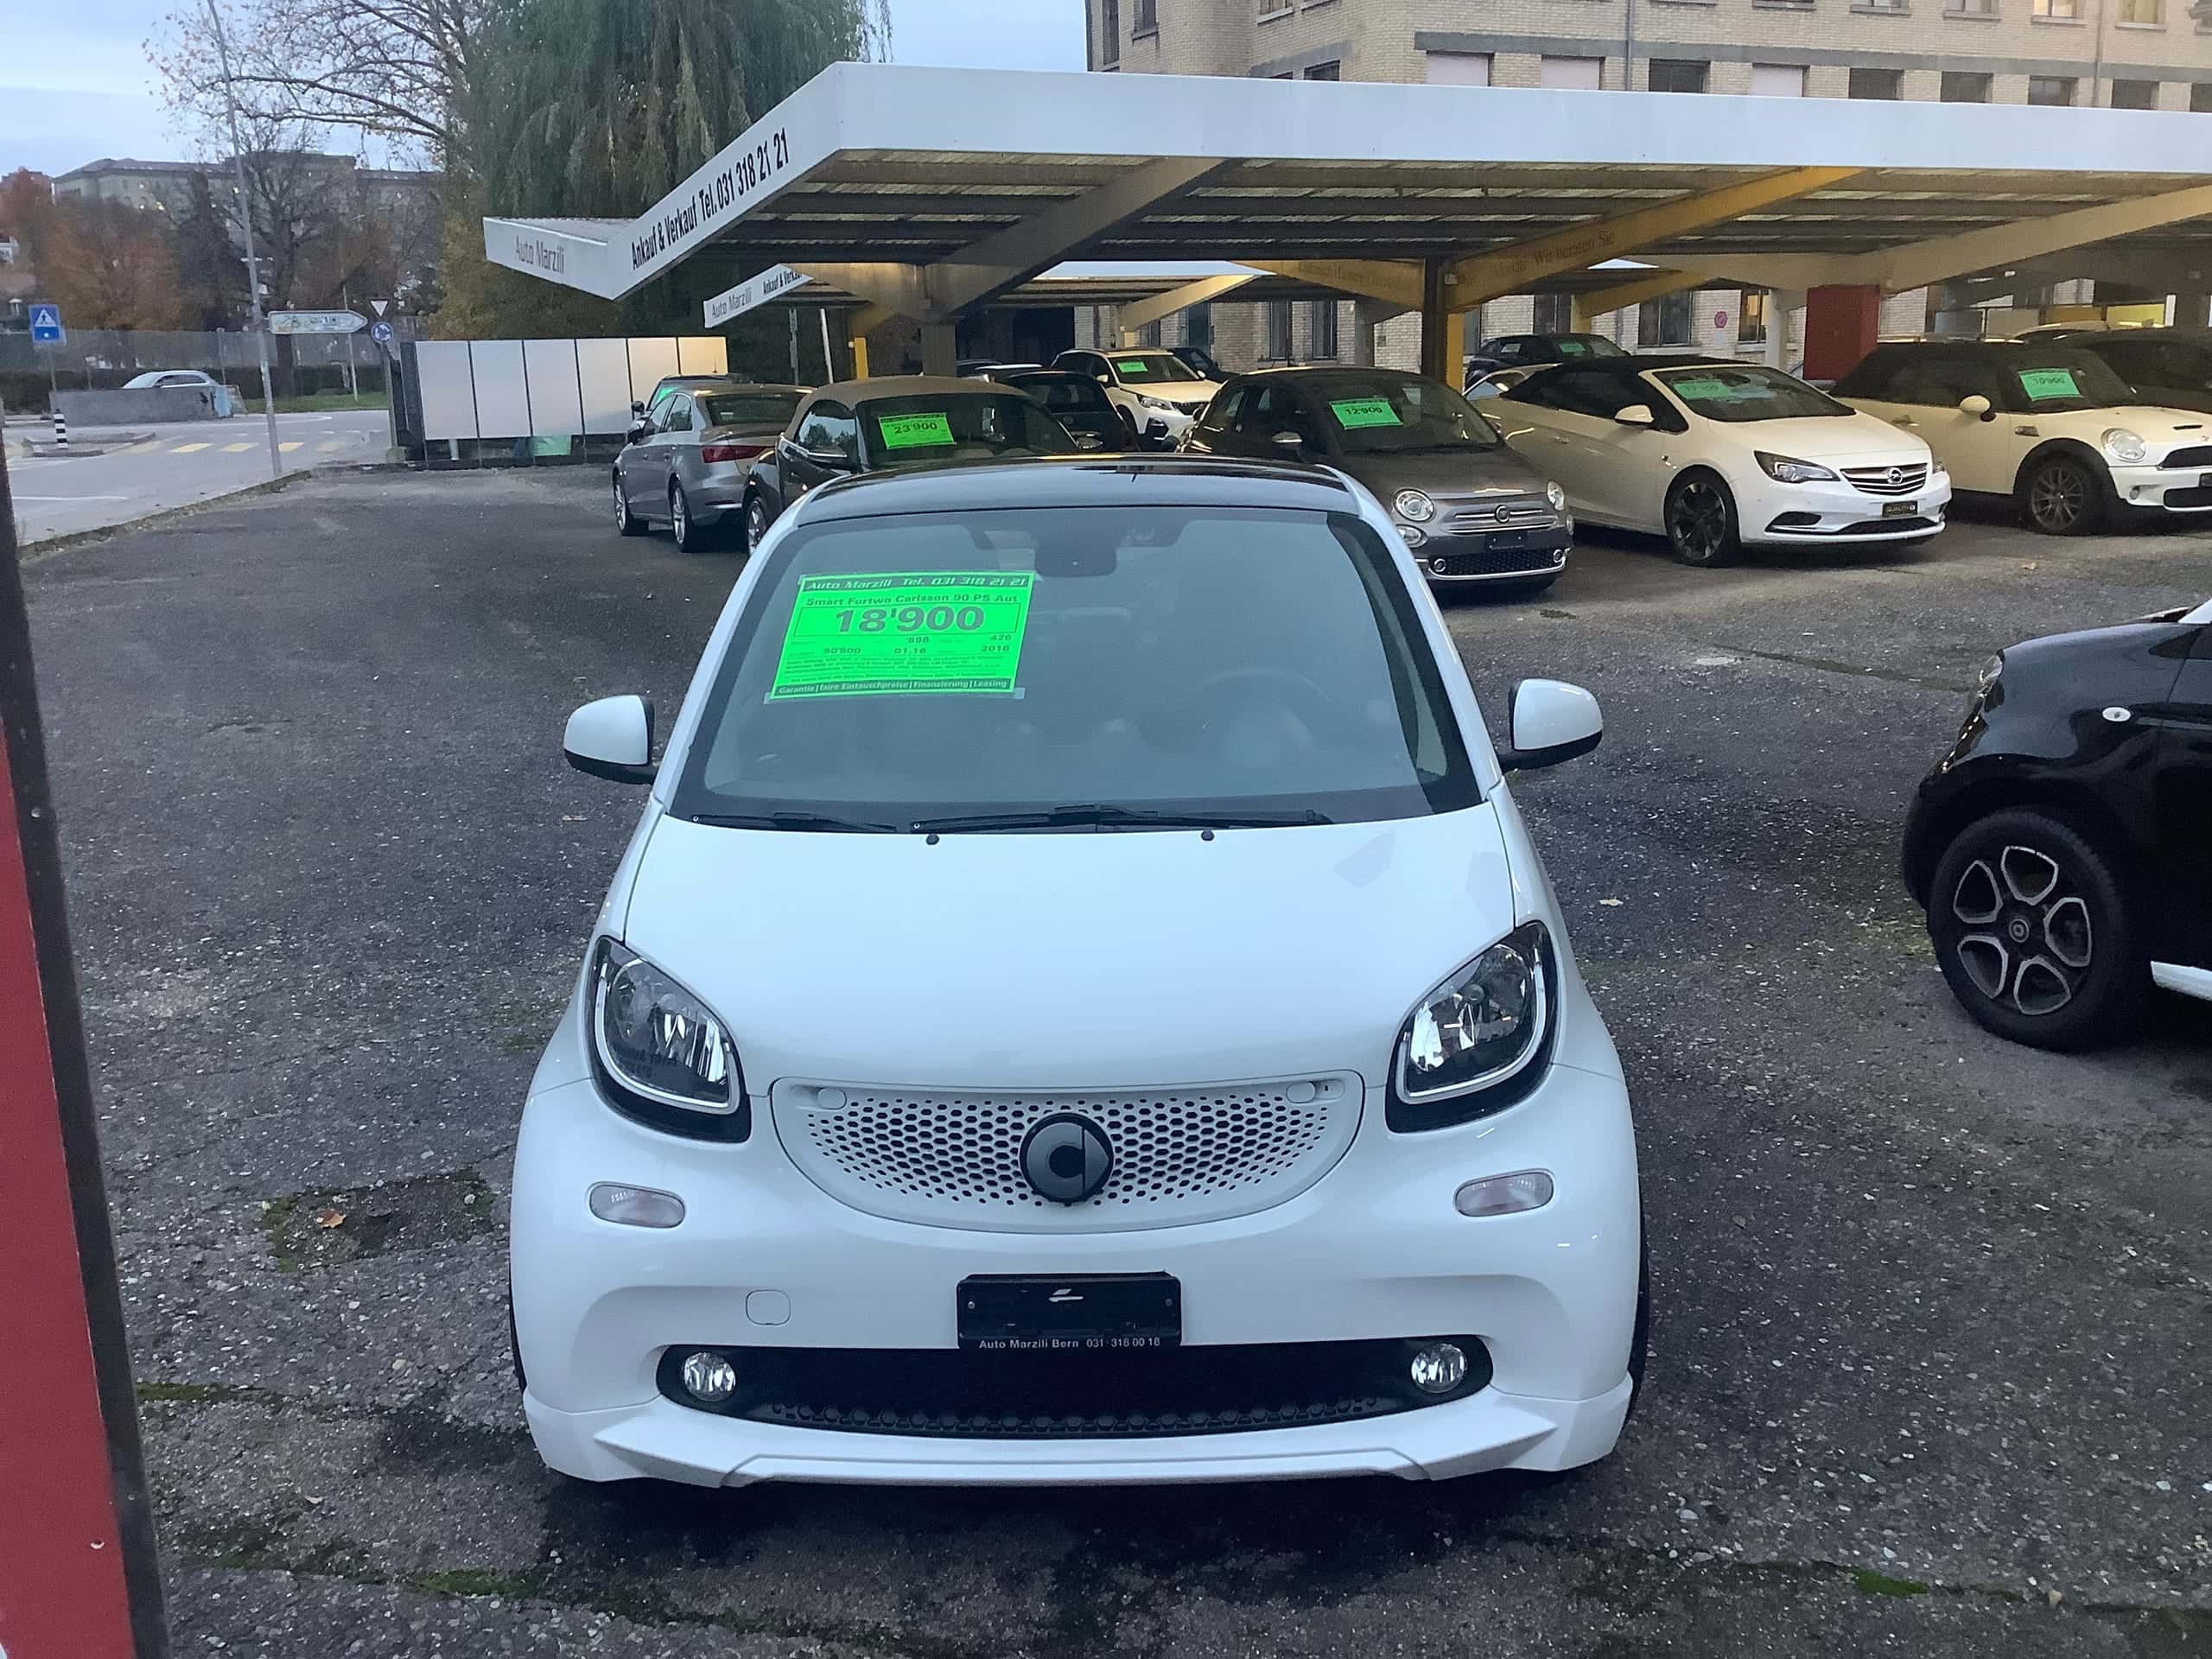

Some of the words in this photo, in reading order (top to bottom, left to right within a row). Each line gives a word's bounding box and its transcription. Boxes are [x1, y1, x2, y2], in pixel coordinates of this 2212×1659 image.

[631, 226, 658, 270] Ankauf
[657, 221, 665, 251] &
[664, 195, 698, 246] Verkauf
[698, 183, 718, 222] Tel.
[716, 168, 735, 210] 031
[735, 153, 756, 196] 318
[757, 140, 772, 182] 21
[773, 127, 789, 170] 21
[515, 235, 534, 264] Auto
[536, 239, 565, 275] Marzili
[711, 301, 728, 319] Auto
[844, 578, 893, 589] Marzili
[903, 576, 925, 586] Tel.
[931, 576, 955, 586] 031
[960, 576, 987, 586] 318
[989, 576, 1006, 586] 21
[1009, 576, 1027, 586] 21
[806, 597, 844, 607] Smart
[953, 594, 969, 602] 90
[973, 594, 991, 602] PS
[995, 594, 1019, 603] Aut
[836, 606, 985, 633] 18'900
[979, 1339, 1007, 1349] Auto
[1009, 1338, 1048, 1349] Marzili
[1052, 1338, 1079, 1349] Bern
[1086, 1338, 1103, 1348] 031
[1132, 1337, 1146, 1347] 00
[1147, 1336, 1161, 1347] 18
